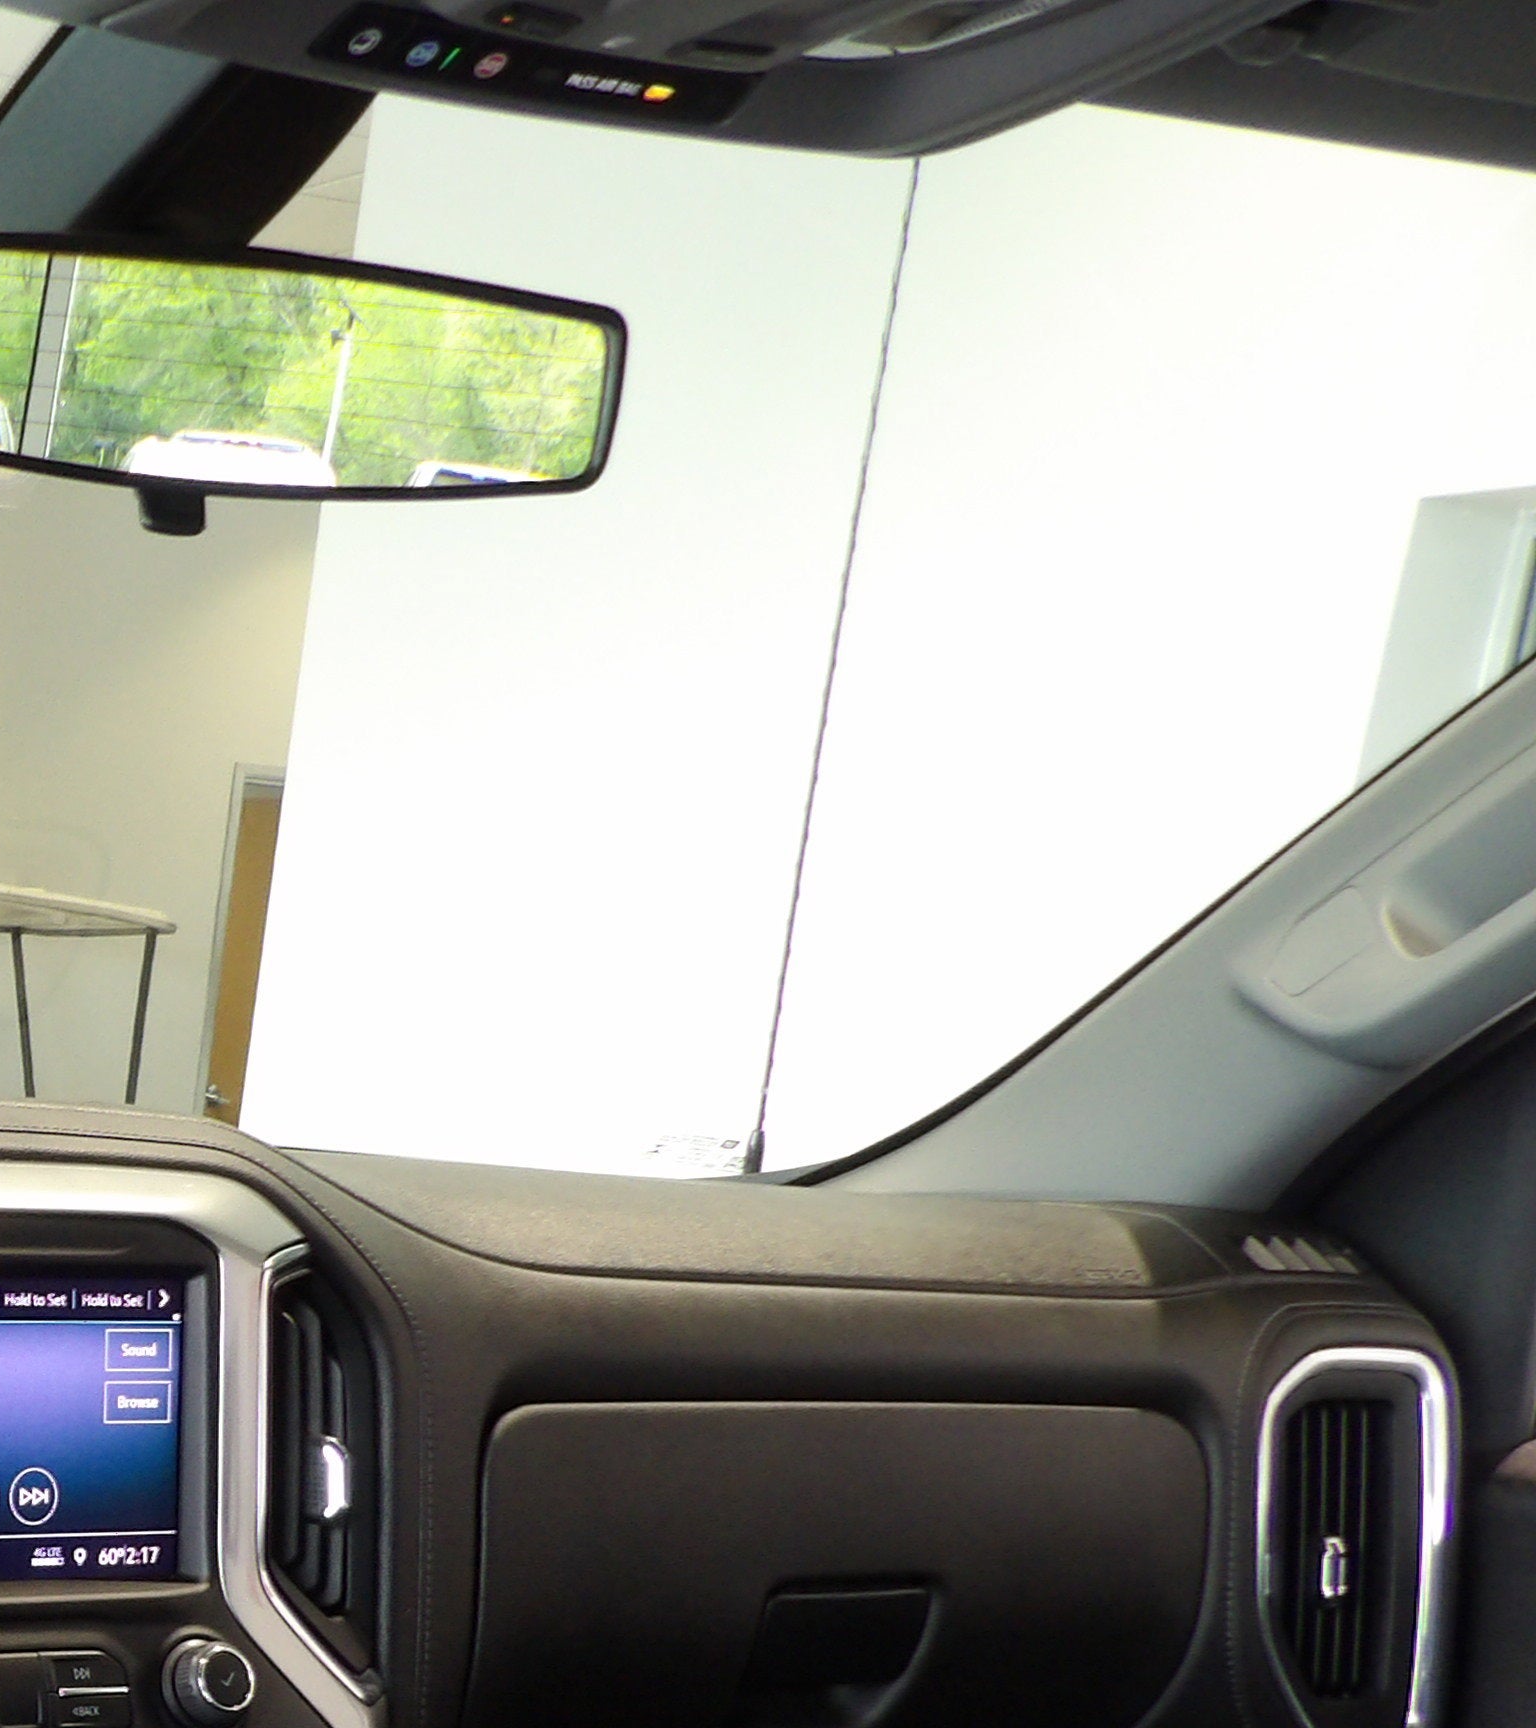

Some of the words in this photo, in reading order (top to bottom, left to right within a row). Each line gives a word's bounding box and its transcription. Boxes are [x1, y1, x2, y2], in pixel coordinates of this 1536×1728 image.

[4, 1292, 31, 1307] Hold
[32, 1293, 46, 1307] to
[47, 1292, 67, 1307] Set
[82, 1293, 108, 1308] Hold
[109, 1294, 122, 1308] to
[123, 1293, 143, 1308] Set
[121, 1342, 158, 1357] Sound
[117, 1395, 159, 1409] Browse
[126, 1546, 160, 1564] 2:17
